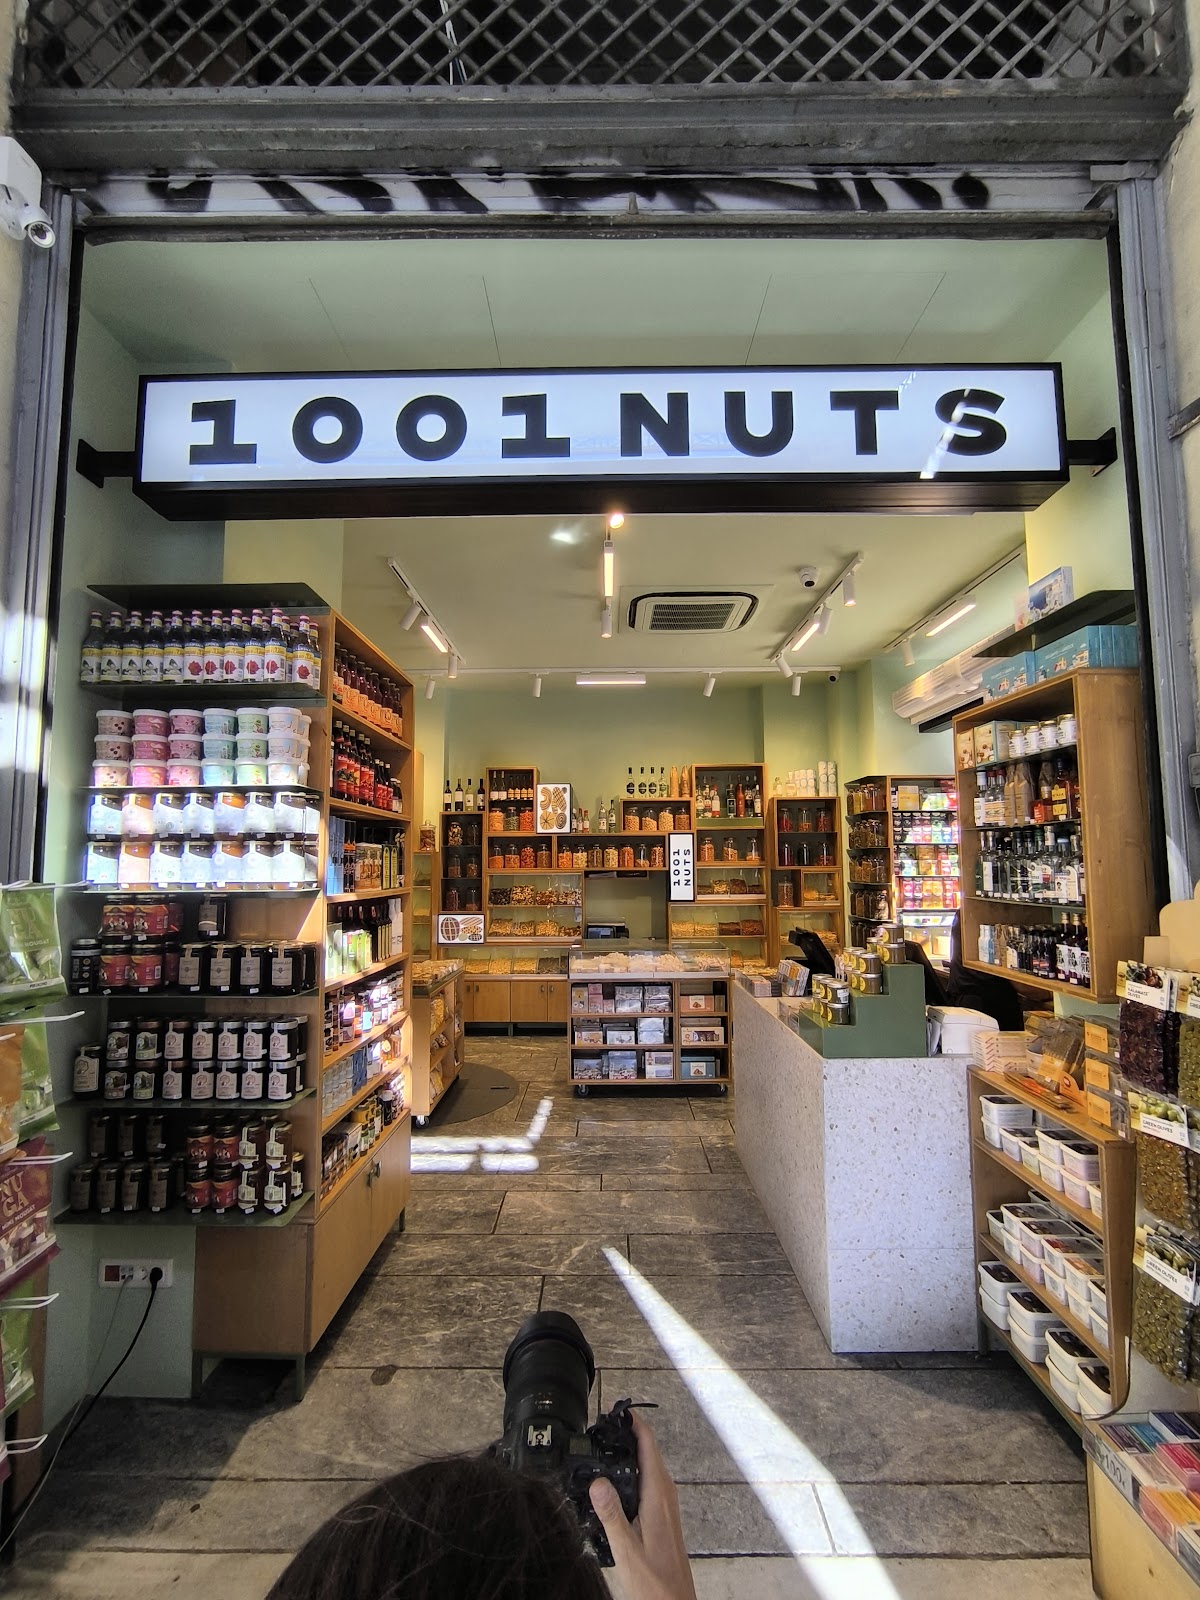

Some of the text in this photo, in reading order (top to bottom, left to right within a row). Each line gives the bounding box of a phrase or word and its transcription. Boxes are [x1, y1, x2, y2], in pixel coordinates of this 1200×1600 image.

[673, 848, 681, 887] 1001
[683, 849, 691, 886] NUTS
[24, 938, 50, 948] NOUGAT
[1142, 1119, 1157, 1128] GREEN
[1157, 1123, 1173, 1134] OLIVES
[2, 1190, 30, 1218] GA
